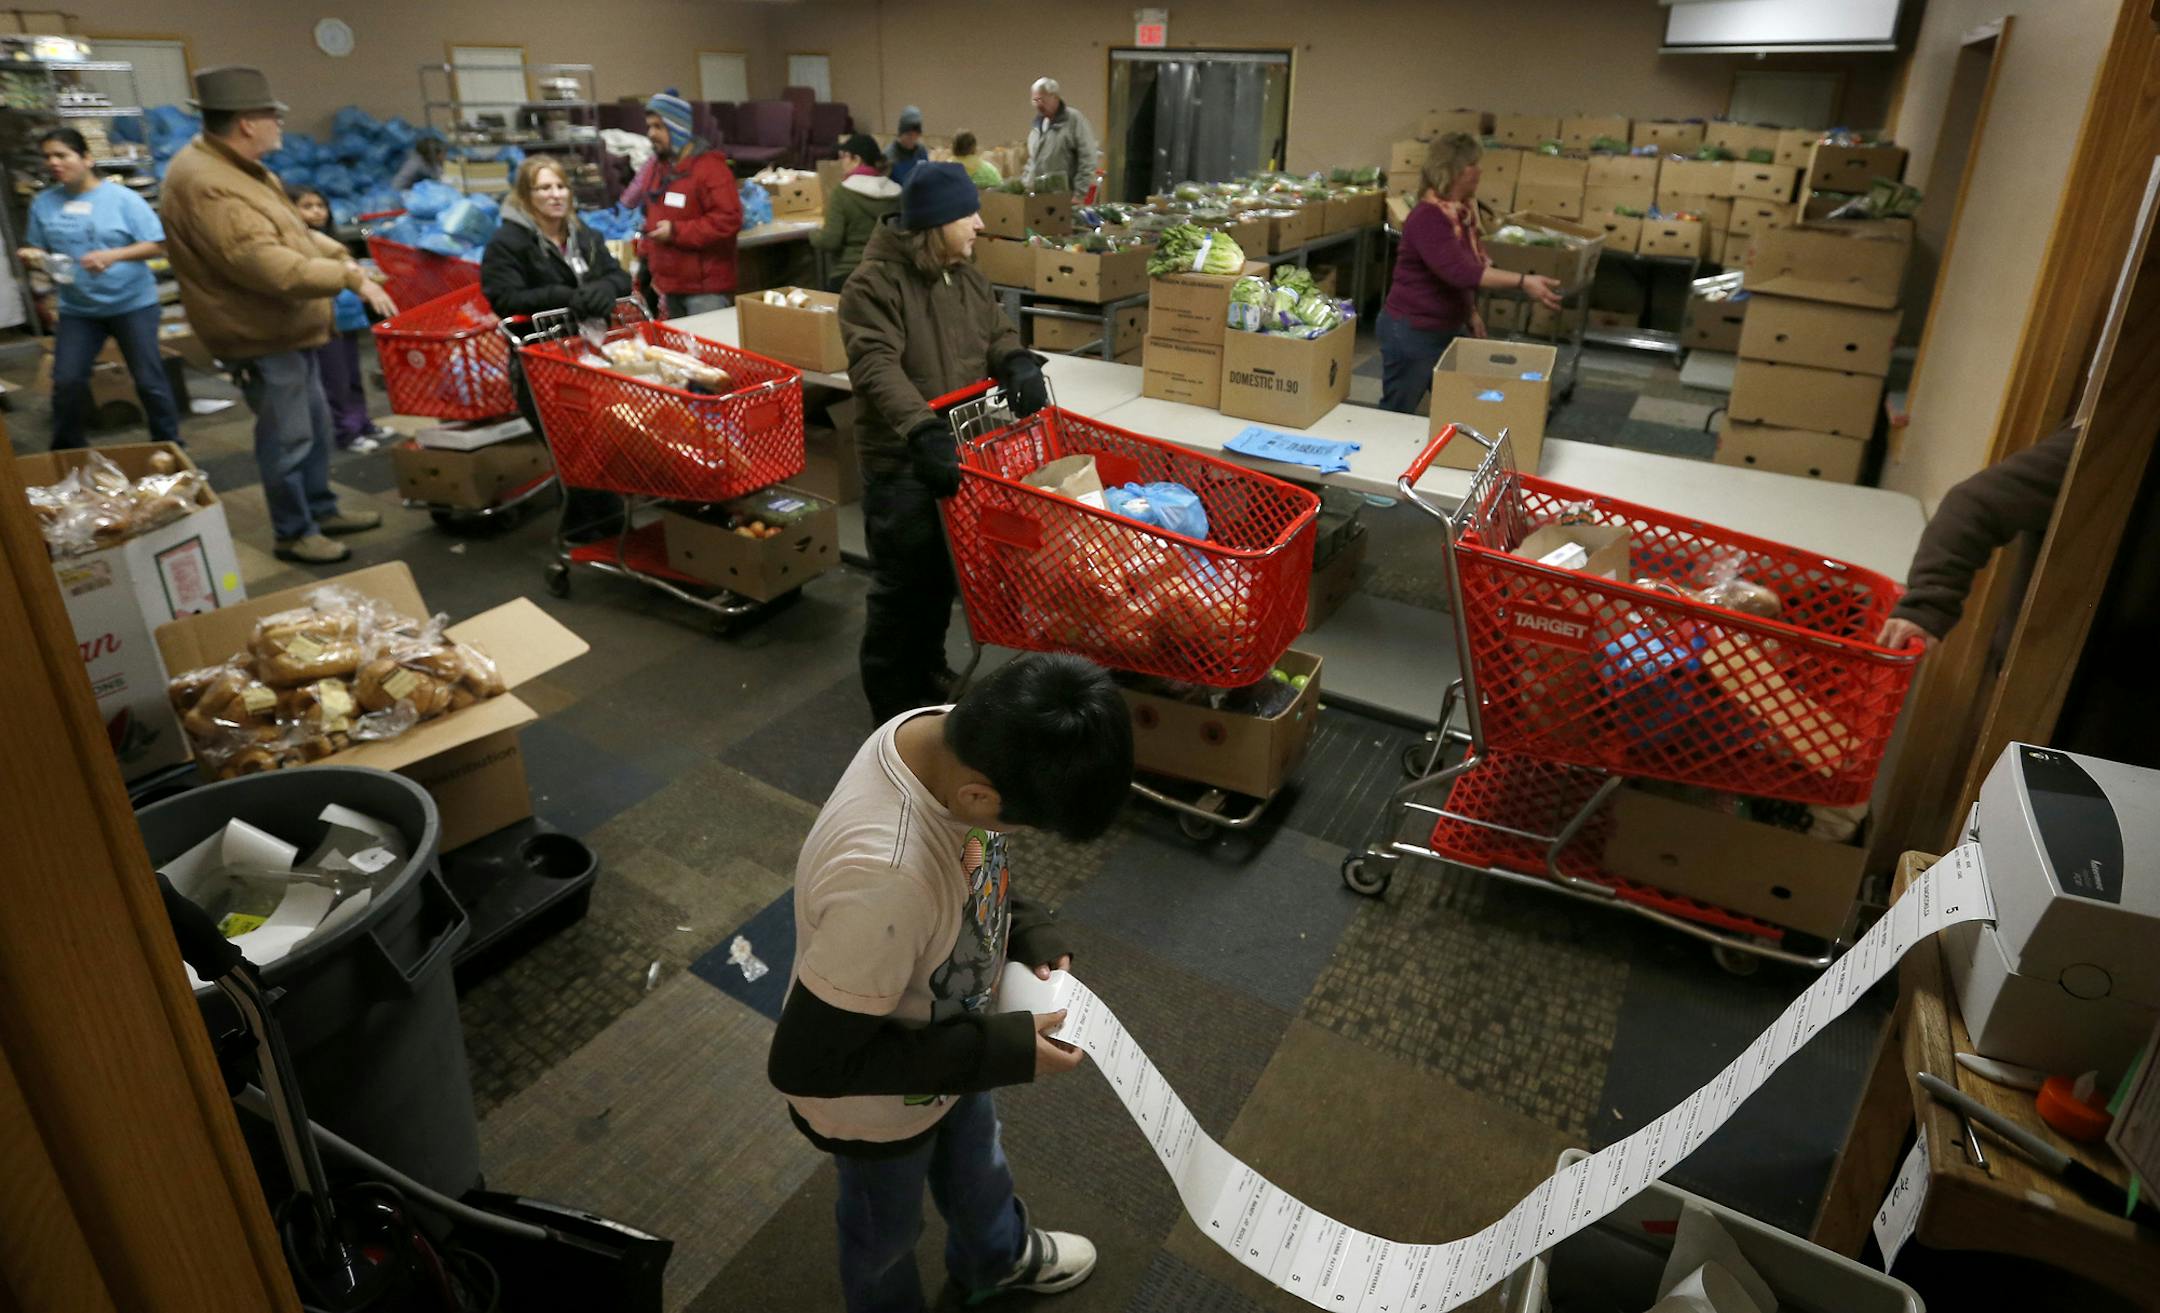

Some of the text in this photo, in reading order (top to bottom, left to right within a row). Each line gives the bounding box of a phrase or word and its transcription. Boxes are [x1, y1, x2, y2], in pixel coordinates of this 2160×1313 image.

[1229, 370, 1299, 394] DOMESTIC 11.90
[1515, 612, 1589, 639] TARGET
[1946, 906, 1958, 914] 5
[1250, 1249, 1258, 1257] 5
[1292, 1274, 1300, 1282] 5
[1323, 1258, 1336, 1286] PATTERSON
